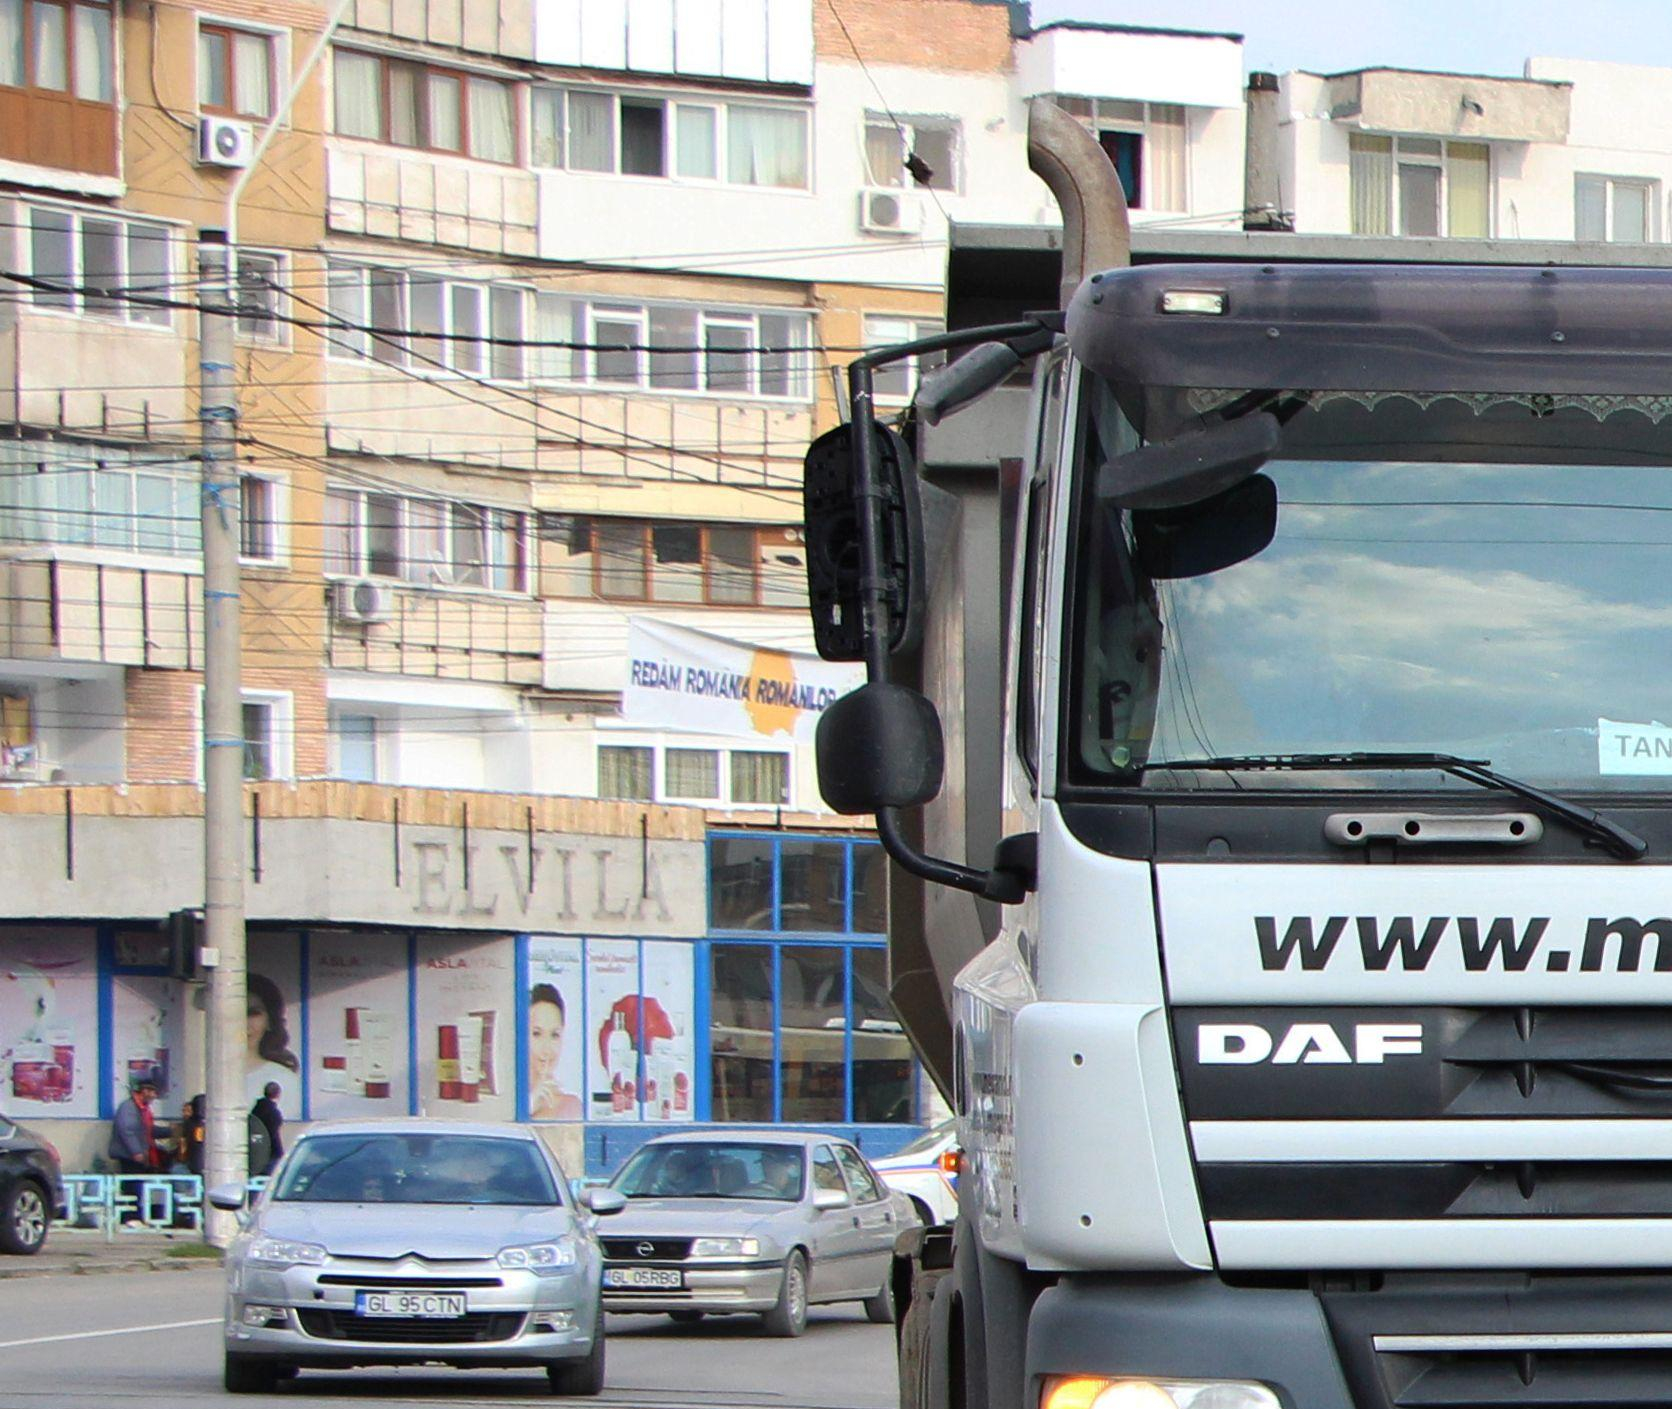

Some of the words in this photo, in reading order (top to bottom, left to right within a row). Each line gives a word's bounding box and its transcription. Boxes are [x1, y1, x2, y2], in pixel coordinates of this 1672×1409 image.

[412, 841, 674, 922] ELVILA
[1198, 1024, 1422, 1064] DAF
[611, 1270, 628, 1284] GL
[368, 1293, 392, 1312] GL
[400, 1293, 421, 1312] 95
[424, 1293, 462, 1312] CTN
